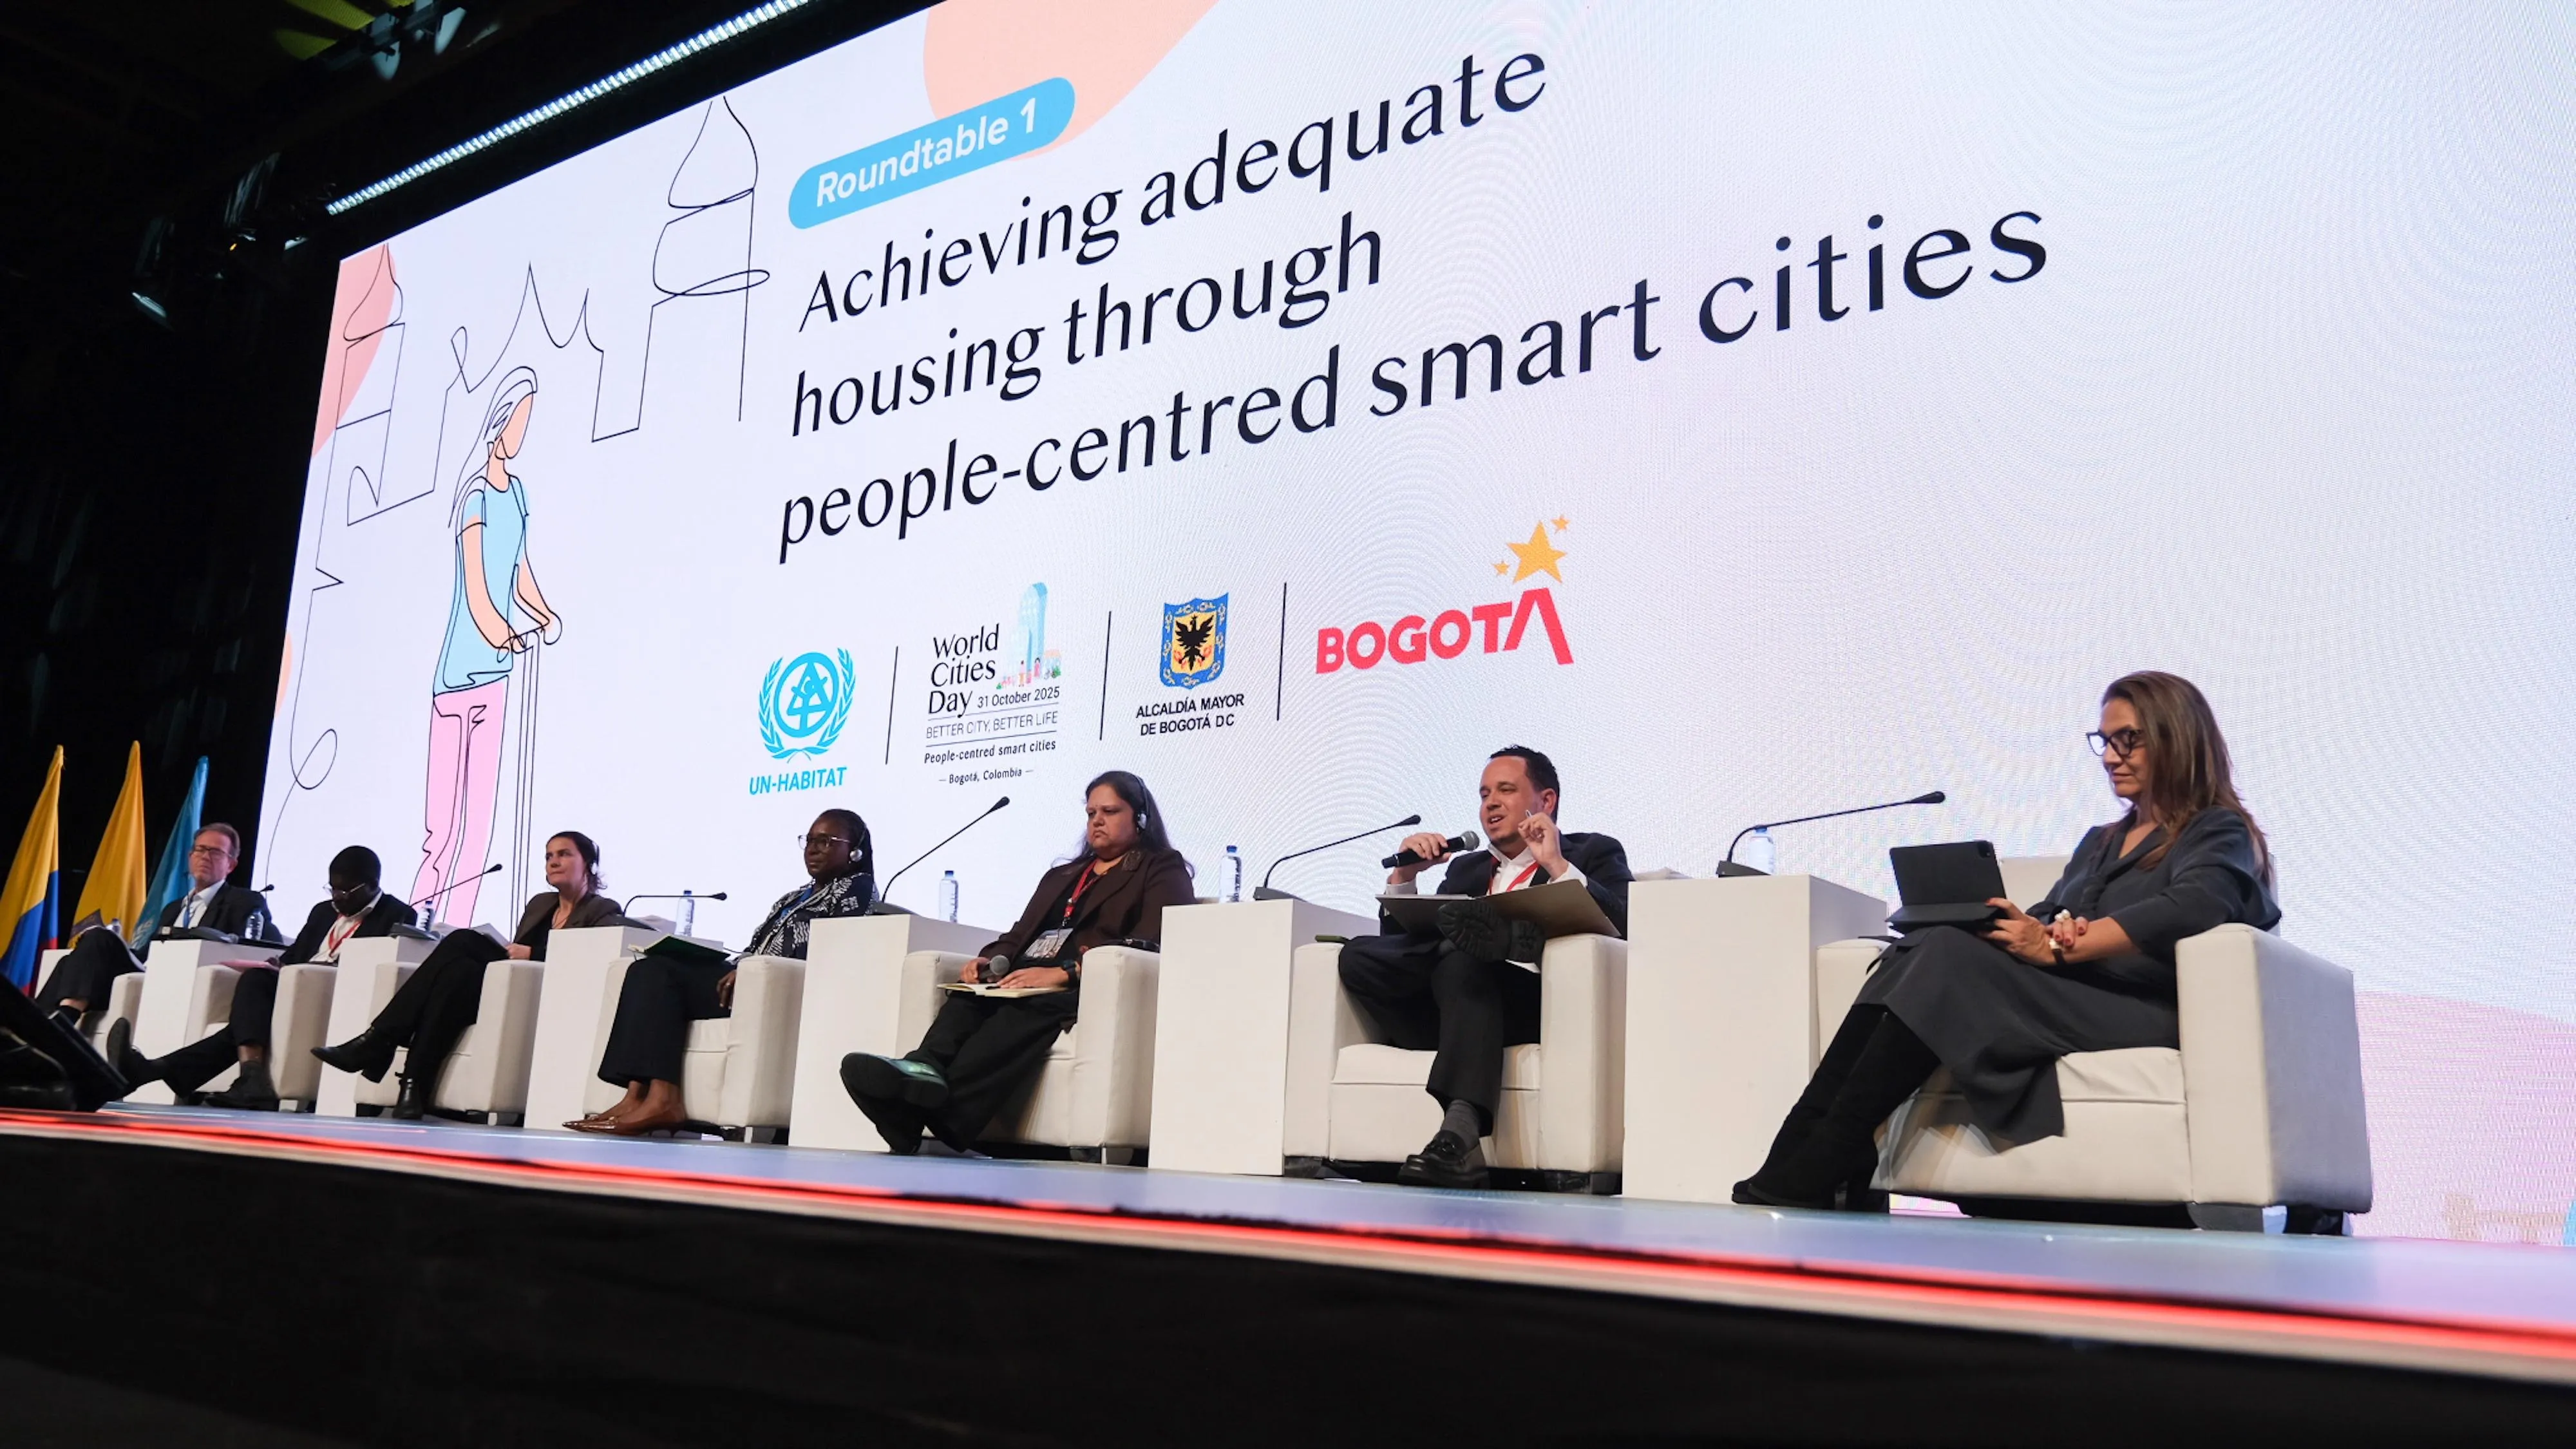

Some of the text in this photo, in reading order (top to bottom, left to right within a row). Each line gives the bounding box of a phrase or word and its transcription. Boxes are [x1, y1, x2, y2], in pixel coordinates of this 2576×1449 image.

[816, 98, 1036, 207] Roundtable 1
[799, 53, 1546, 332] Achieving adequate
[793, 211, 1381, 437] housing through
[779, 211, 2047, 565] people-centred smart cities
[933, 623, 999, 659] World
[931, 656, 996, 687] Cities
[929, 690, 972, 718] Day
[978, 686, 1060, 708] 31 October 2025
[1136, 694, 1245, 718] ALCALDÍA MAYOR
[927, 711, 1058, 739] BETTER CITY, BETTER LIFE
[1141, 723, 1157, 736] DE
[1160, 713, 1211, 734] BOGOTÁ
[924, 740, 1056, 764] People-centred smart cities
[749, 766, 847, 795] UN-HABITAT
[983, 768, 1022, 781] Colombia
